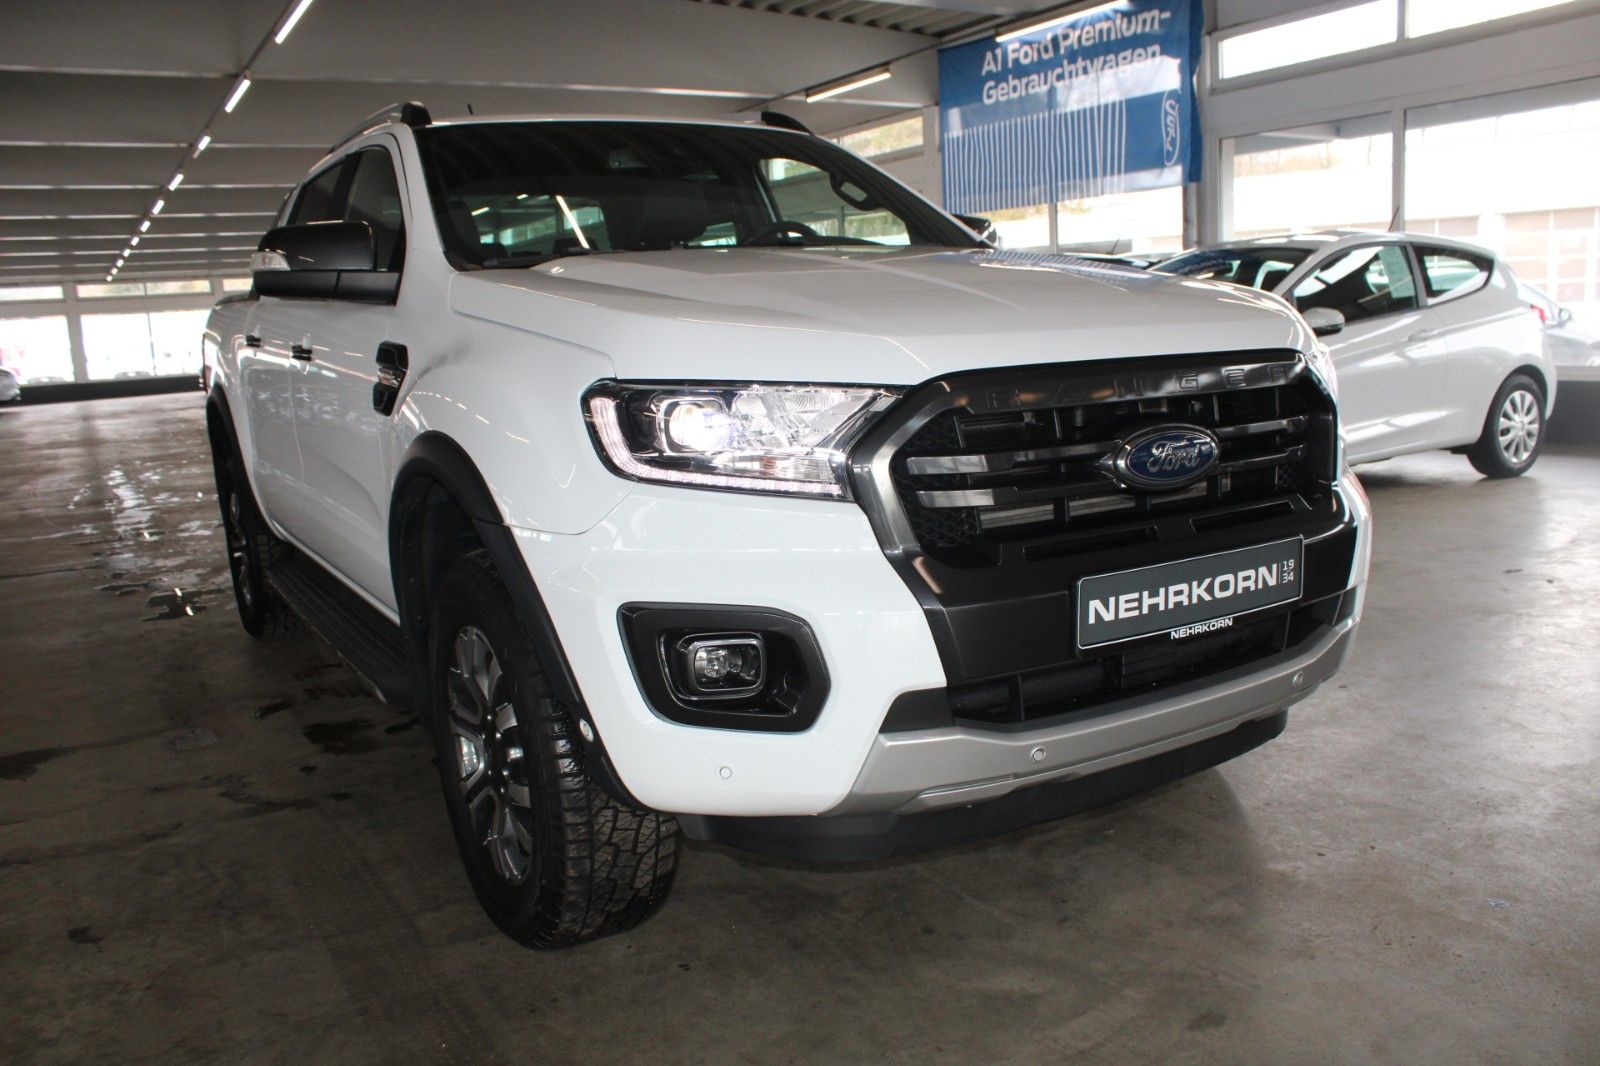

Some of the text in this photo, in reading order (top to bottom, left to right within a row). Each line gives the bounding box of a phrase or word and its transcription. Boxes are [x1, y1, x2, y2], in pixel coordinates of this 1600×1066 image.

[981, 9, 1171, 76] A1 Ford Premium-
[982, 44, 1161, 105] Gebrauchtwagen
[1147, 436, 1200, 474] Ford
[1088, 559, 1295, 625] NEHRKORN 19
[1282, 571, 1294, 583] 34
[1170, 618, 1233, 640] NEHRKORN
